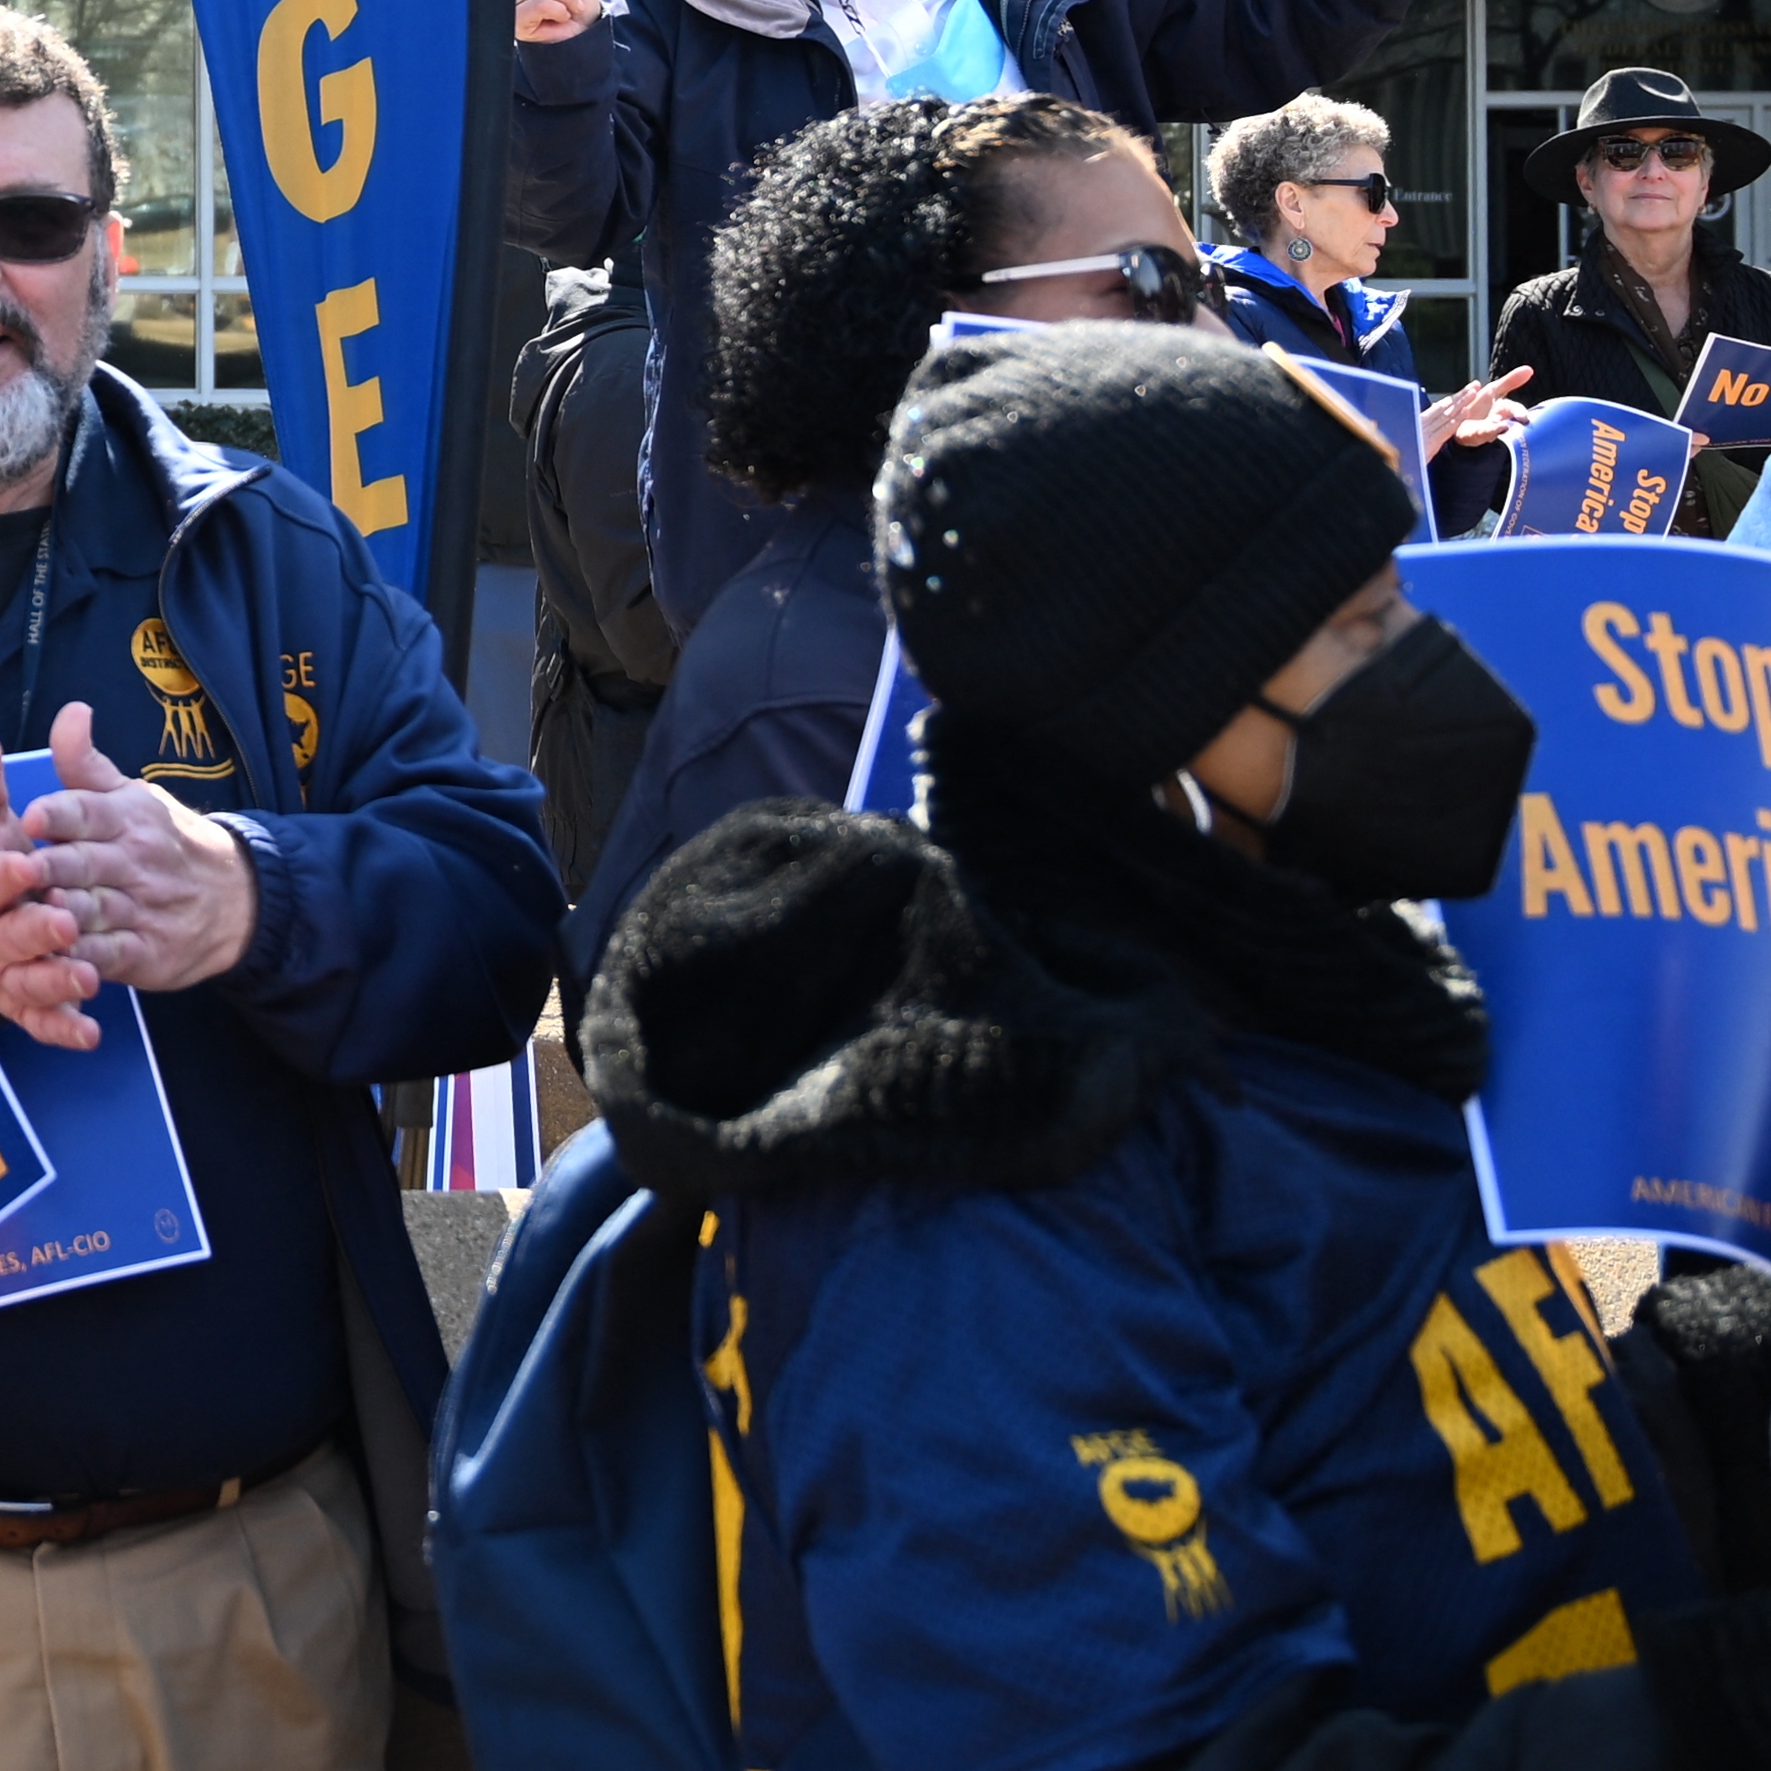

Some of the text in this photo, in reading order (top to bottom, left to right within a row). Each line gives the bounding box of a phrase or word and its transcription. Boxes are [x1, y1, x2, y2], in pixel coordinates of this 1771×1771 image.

[1394, 188, 1453, 203] Entrance
[1707, 369, 1770, 407] No
[1574, 417, 1626, 534] America
[1619, 468, 1667, 534] Stop
[34, 561, 48, 586] THE
[31, 589, 44, 607] OF
[27, 611, 44, 645] HALL
[280, 651, 317, 689] GE
[1518, 792, 1771, 933] Ameri
[30, 1230, 112, 1267] AFL-CIO
[1410, 1238, 1635, 1564] AF
